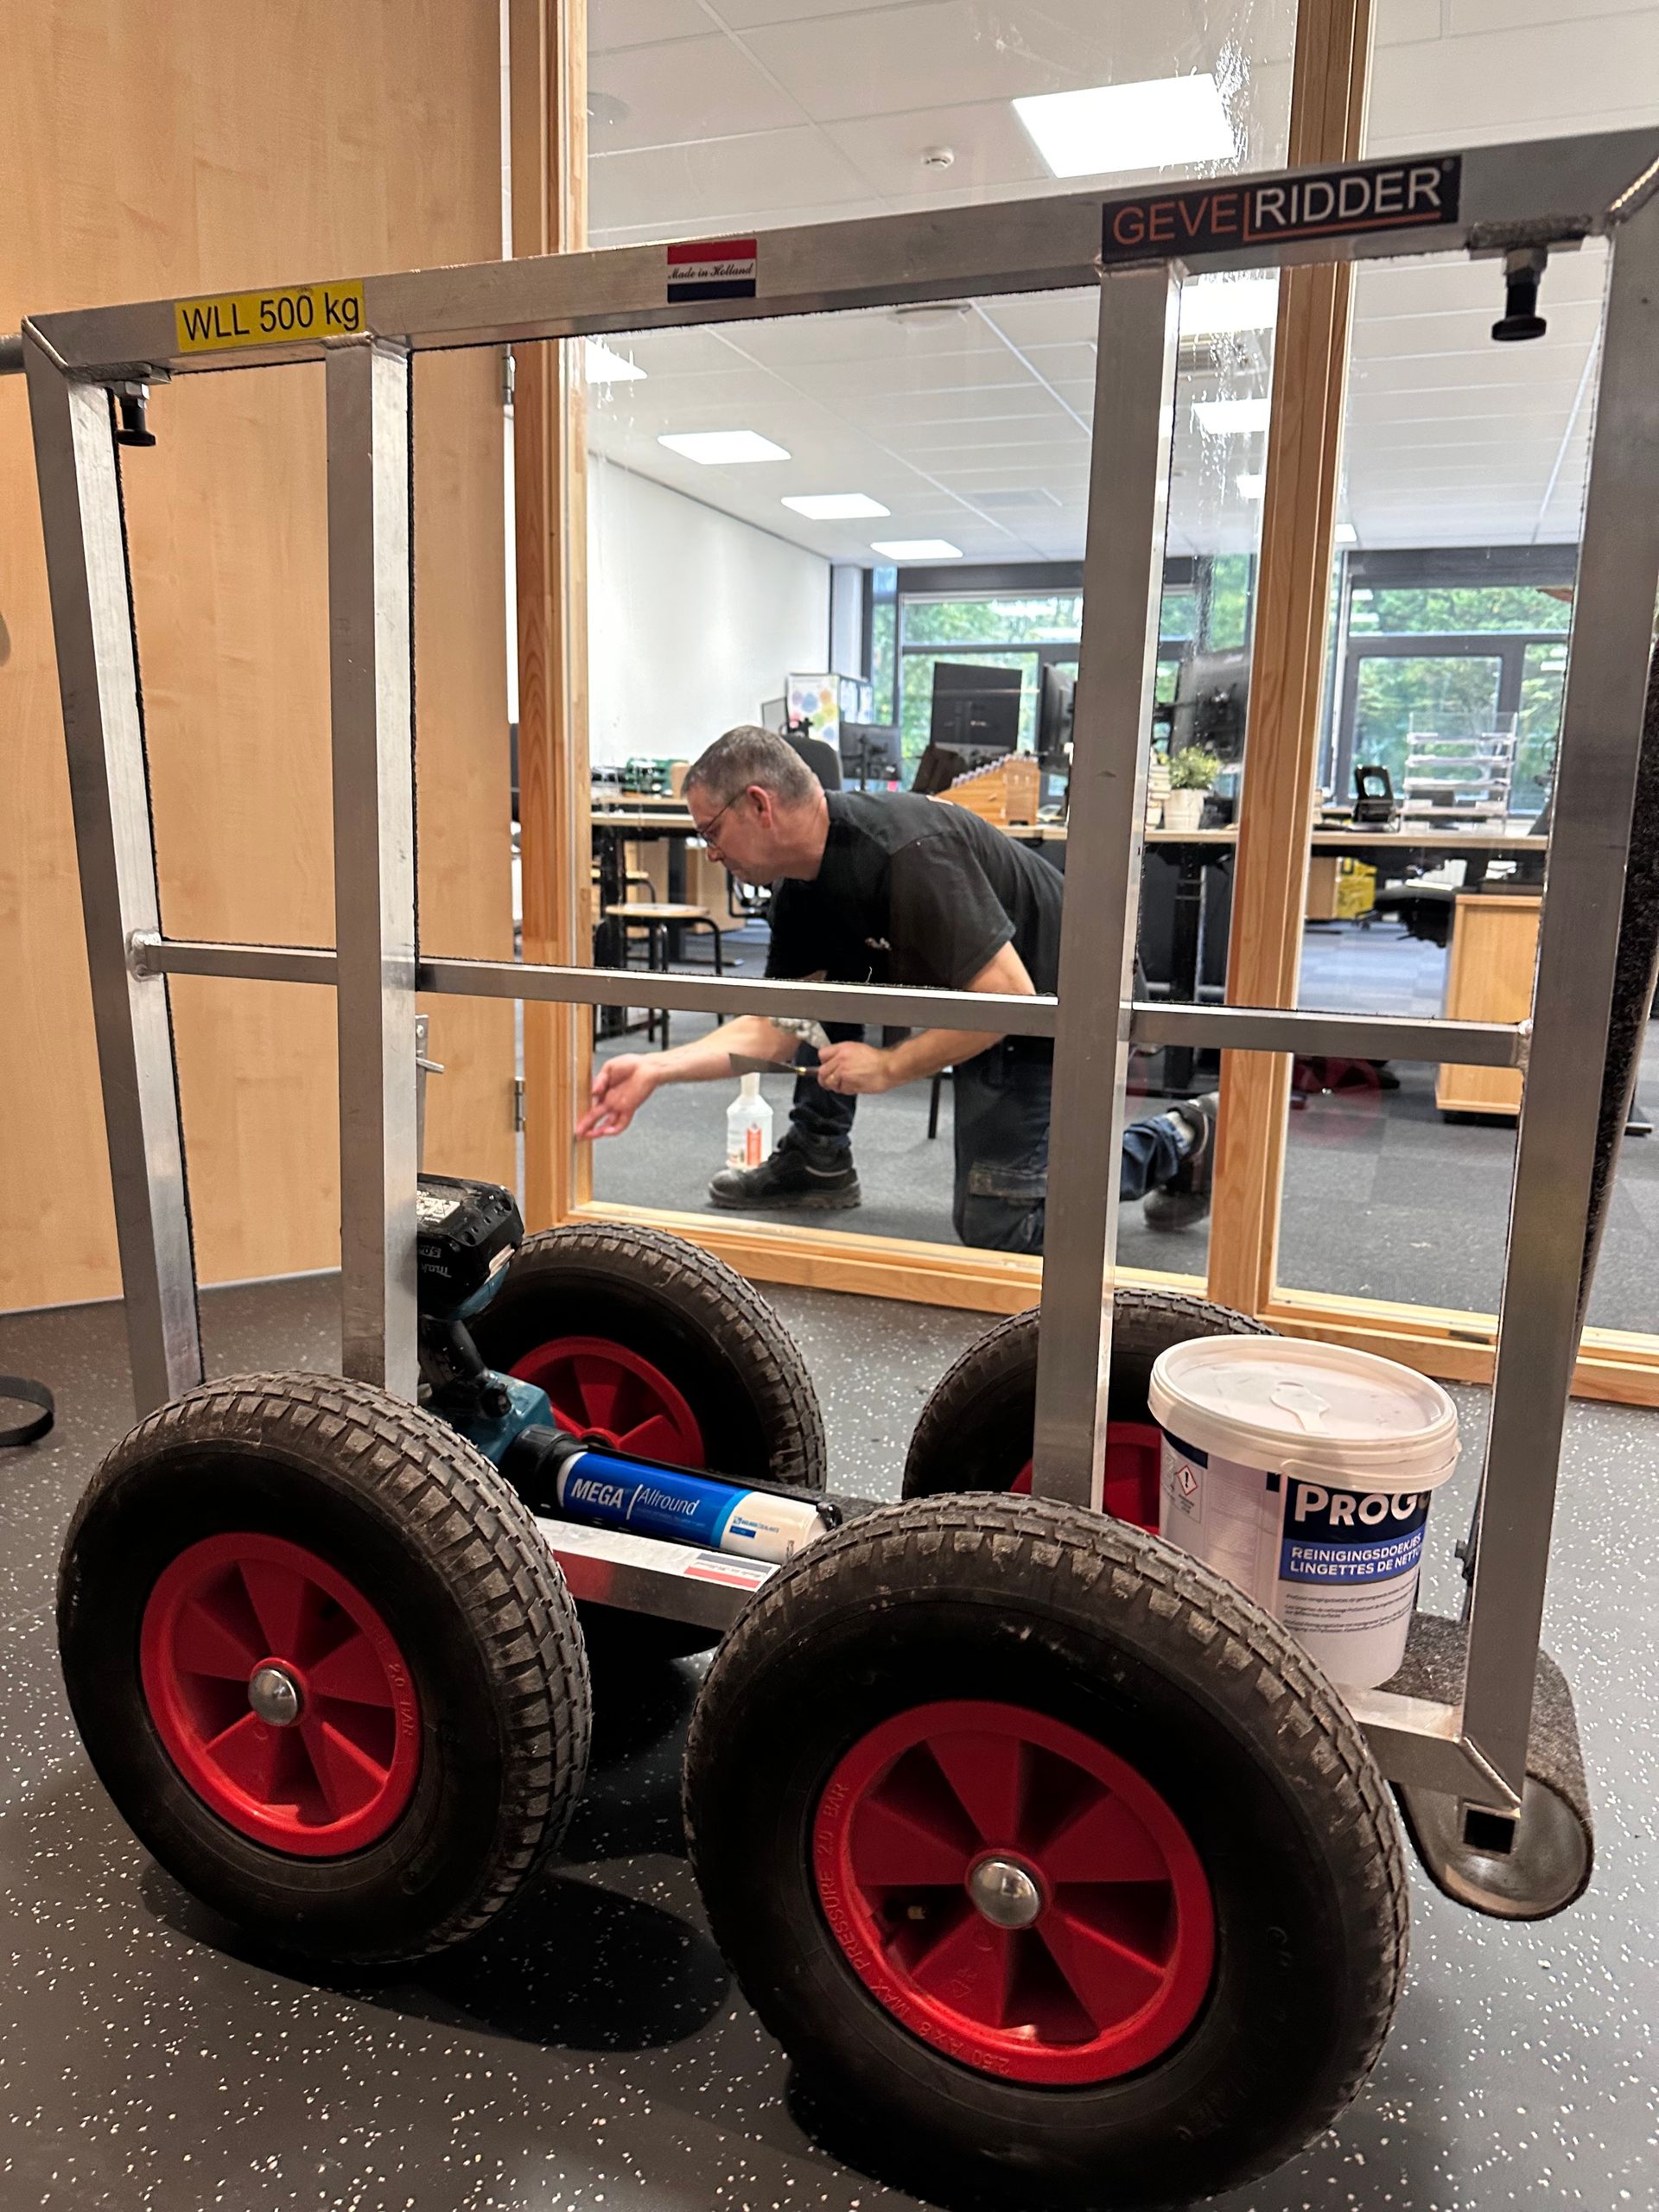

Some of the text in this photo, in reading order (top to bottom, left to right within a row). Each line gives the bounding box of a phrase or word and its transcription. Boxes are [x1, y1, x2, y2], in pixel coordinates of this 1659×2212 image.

[1112, 166, 1443, 246] GEVELRIDDER
[668, 262, 754, 280] Made in Holland
[181, 292, 361, 342] WLL 500 kg
[570, 1477, 701, 1516] MEGA Allround
[1291, 1532, 1422, 1562] REINIGINGSDOEKJES
[1289, 1560, 1375, 1576] LINGETTES
[1376, 1559, 1394, 1573] DE
[822, 1782, 850, 1820] BAR
[817, 1869, 872, 1976] PRESSURE
